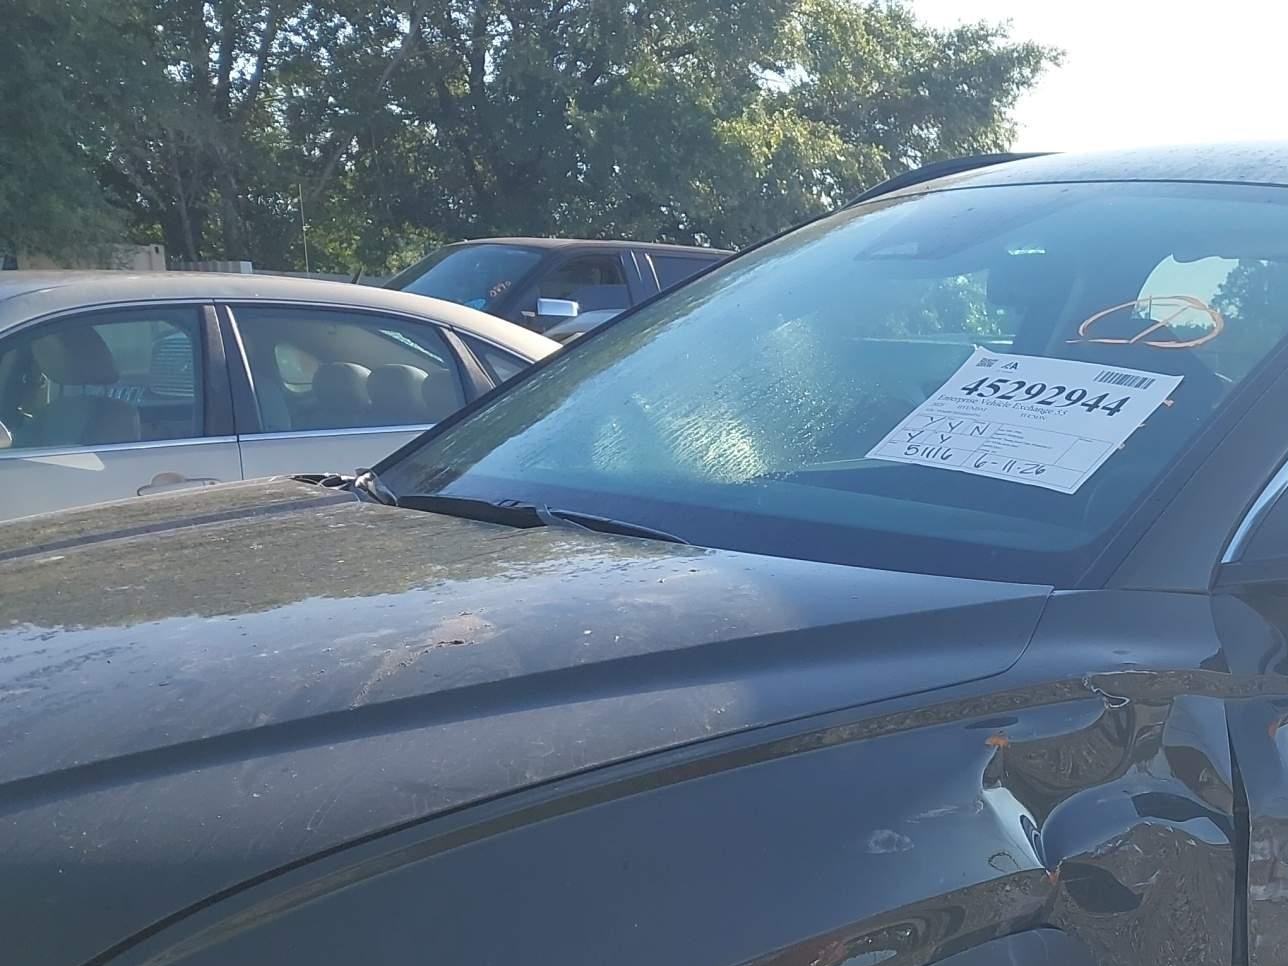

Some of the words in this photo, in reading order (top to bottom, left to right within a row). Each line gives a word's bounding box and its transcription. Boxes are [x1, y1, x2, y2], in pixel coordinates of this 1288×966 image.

[961, 376, 1131, 417] 45292944
[948, 421, 964, 434] Y
[969, 423, 991, 436] N
[906, 432, 925, 443] Y
[940, 434, 953, 444] Y
